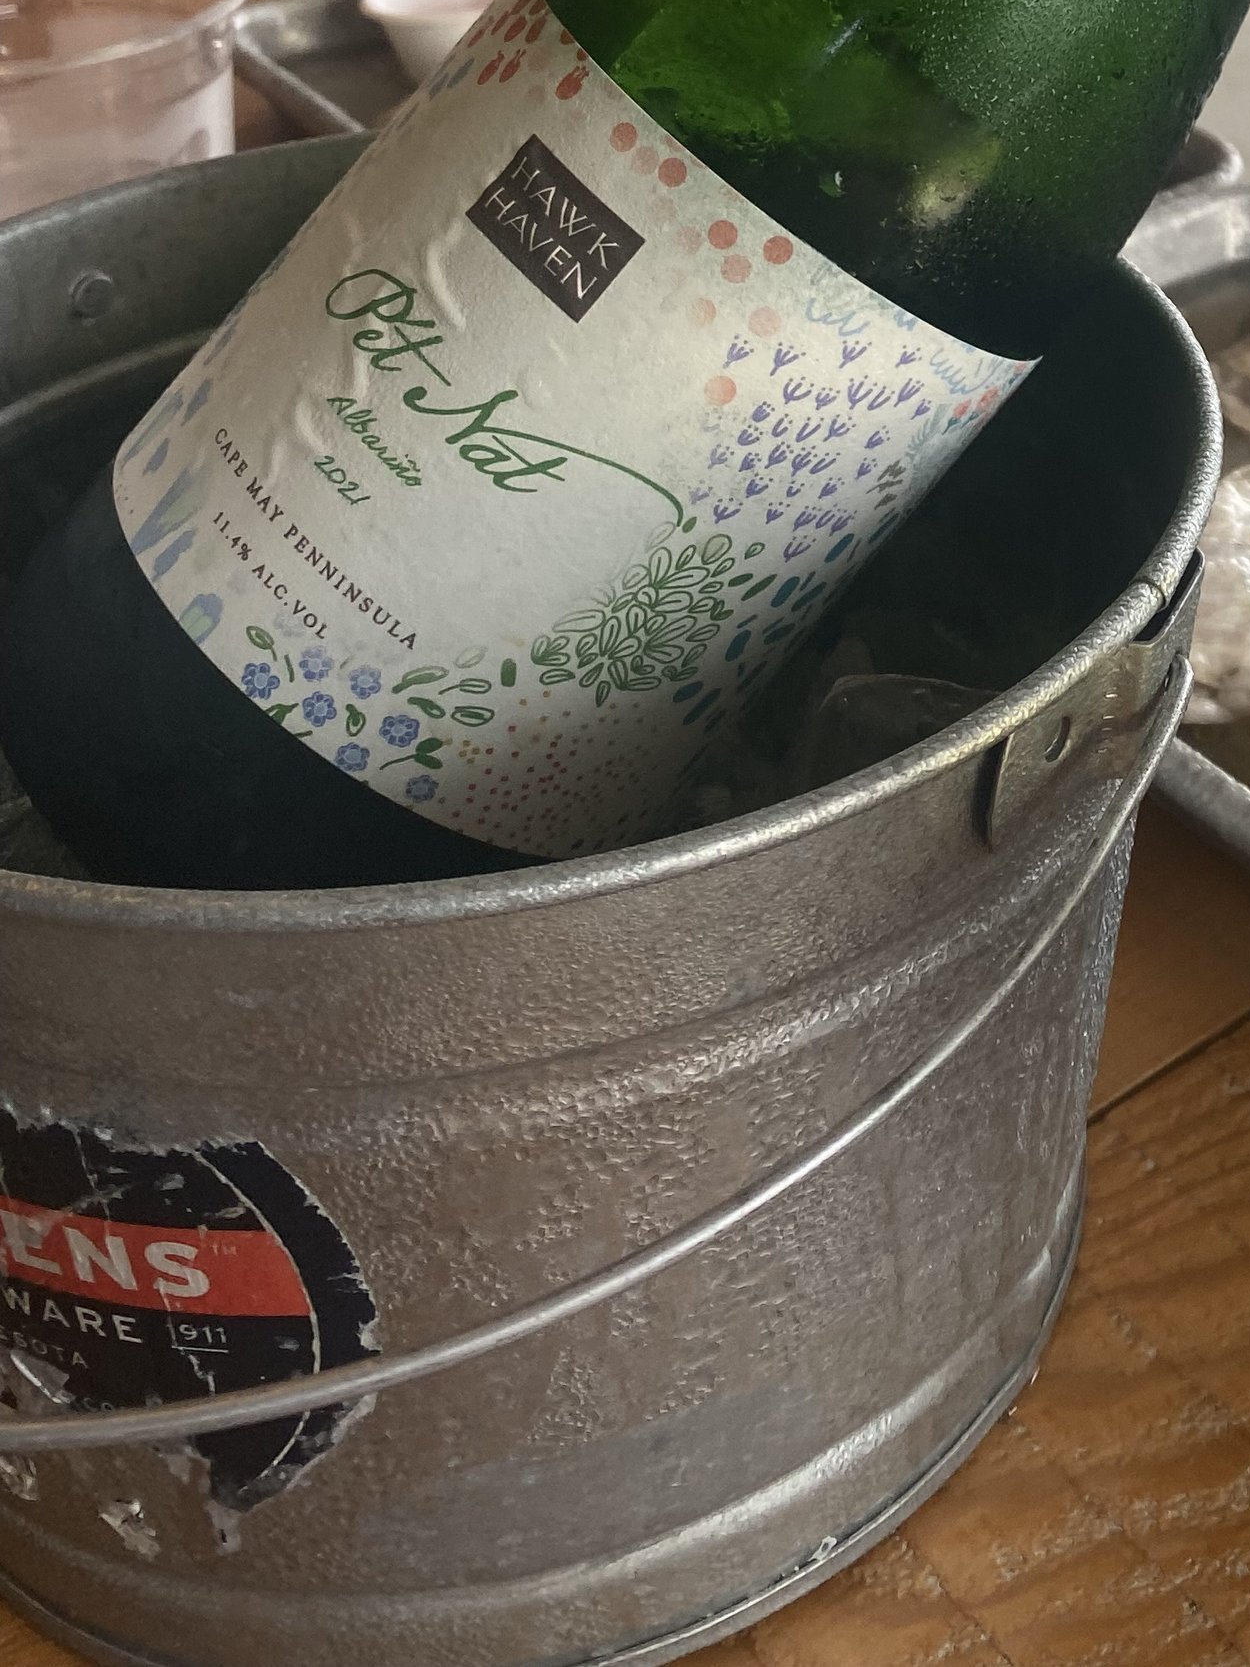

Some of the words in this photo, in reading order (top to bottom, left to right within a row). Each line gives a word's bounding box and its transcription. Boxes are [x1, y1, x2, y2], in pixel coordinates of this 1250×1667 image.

[484, 186, 598, 300] HAVEN
[511, 156, 620, 271] HAWK
[212, 511, 252, 562] 11.4%
[314, 454, 371, 506] 2021
[214, 428, 249, 478] CAPE
[246, 477, 285, 523] MAY
[282, 522, 417, 651] PENNINSULA
